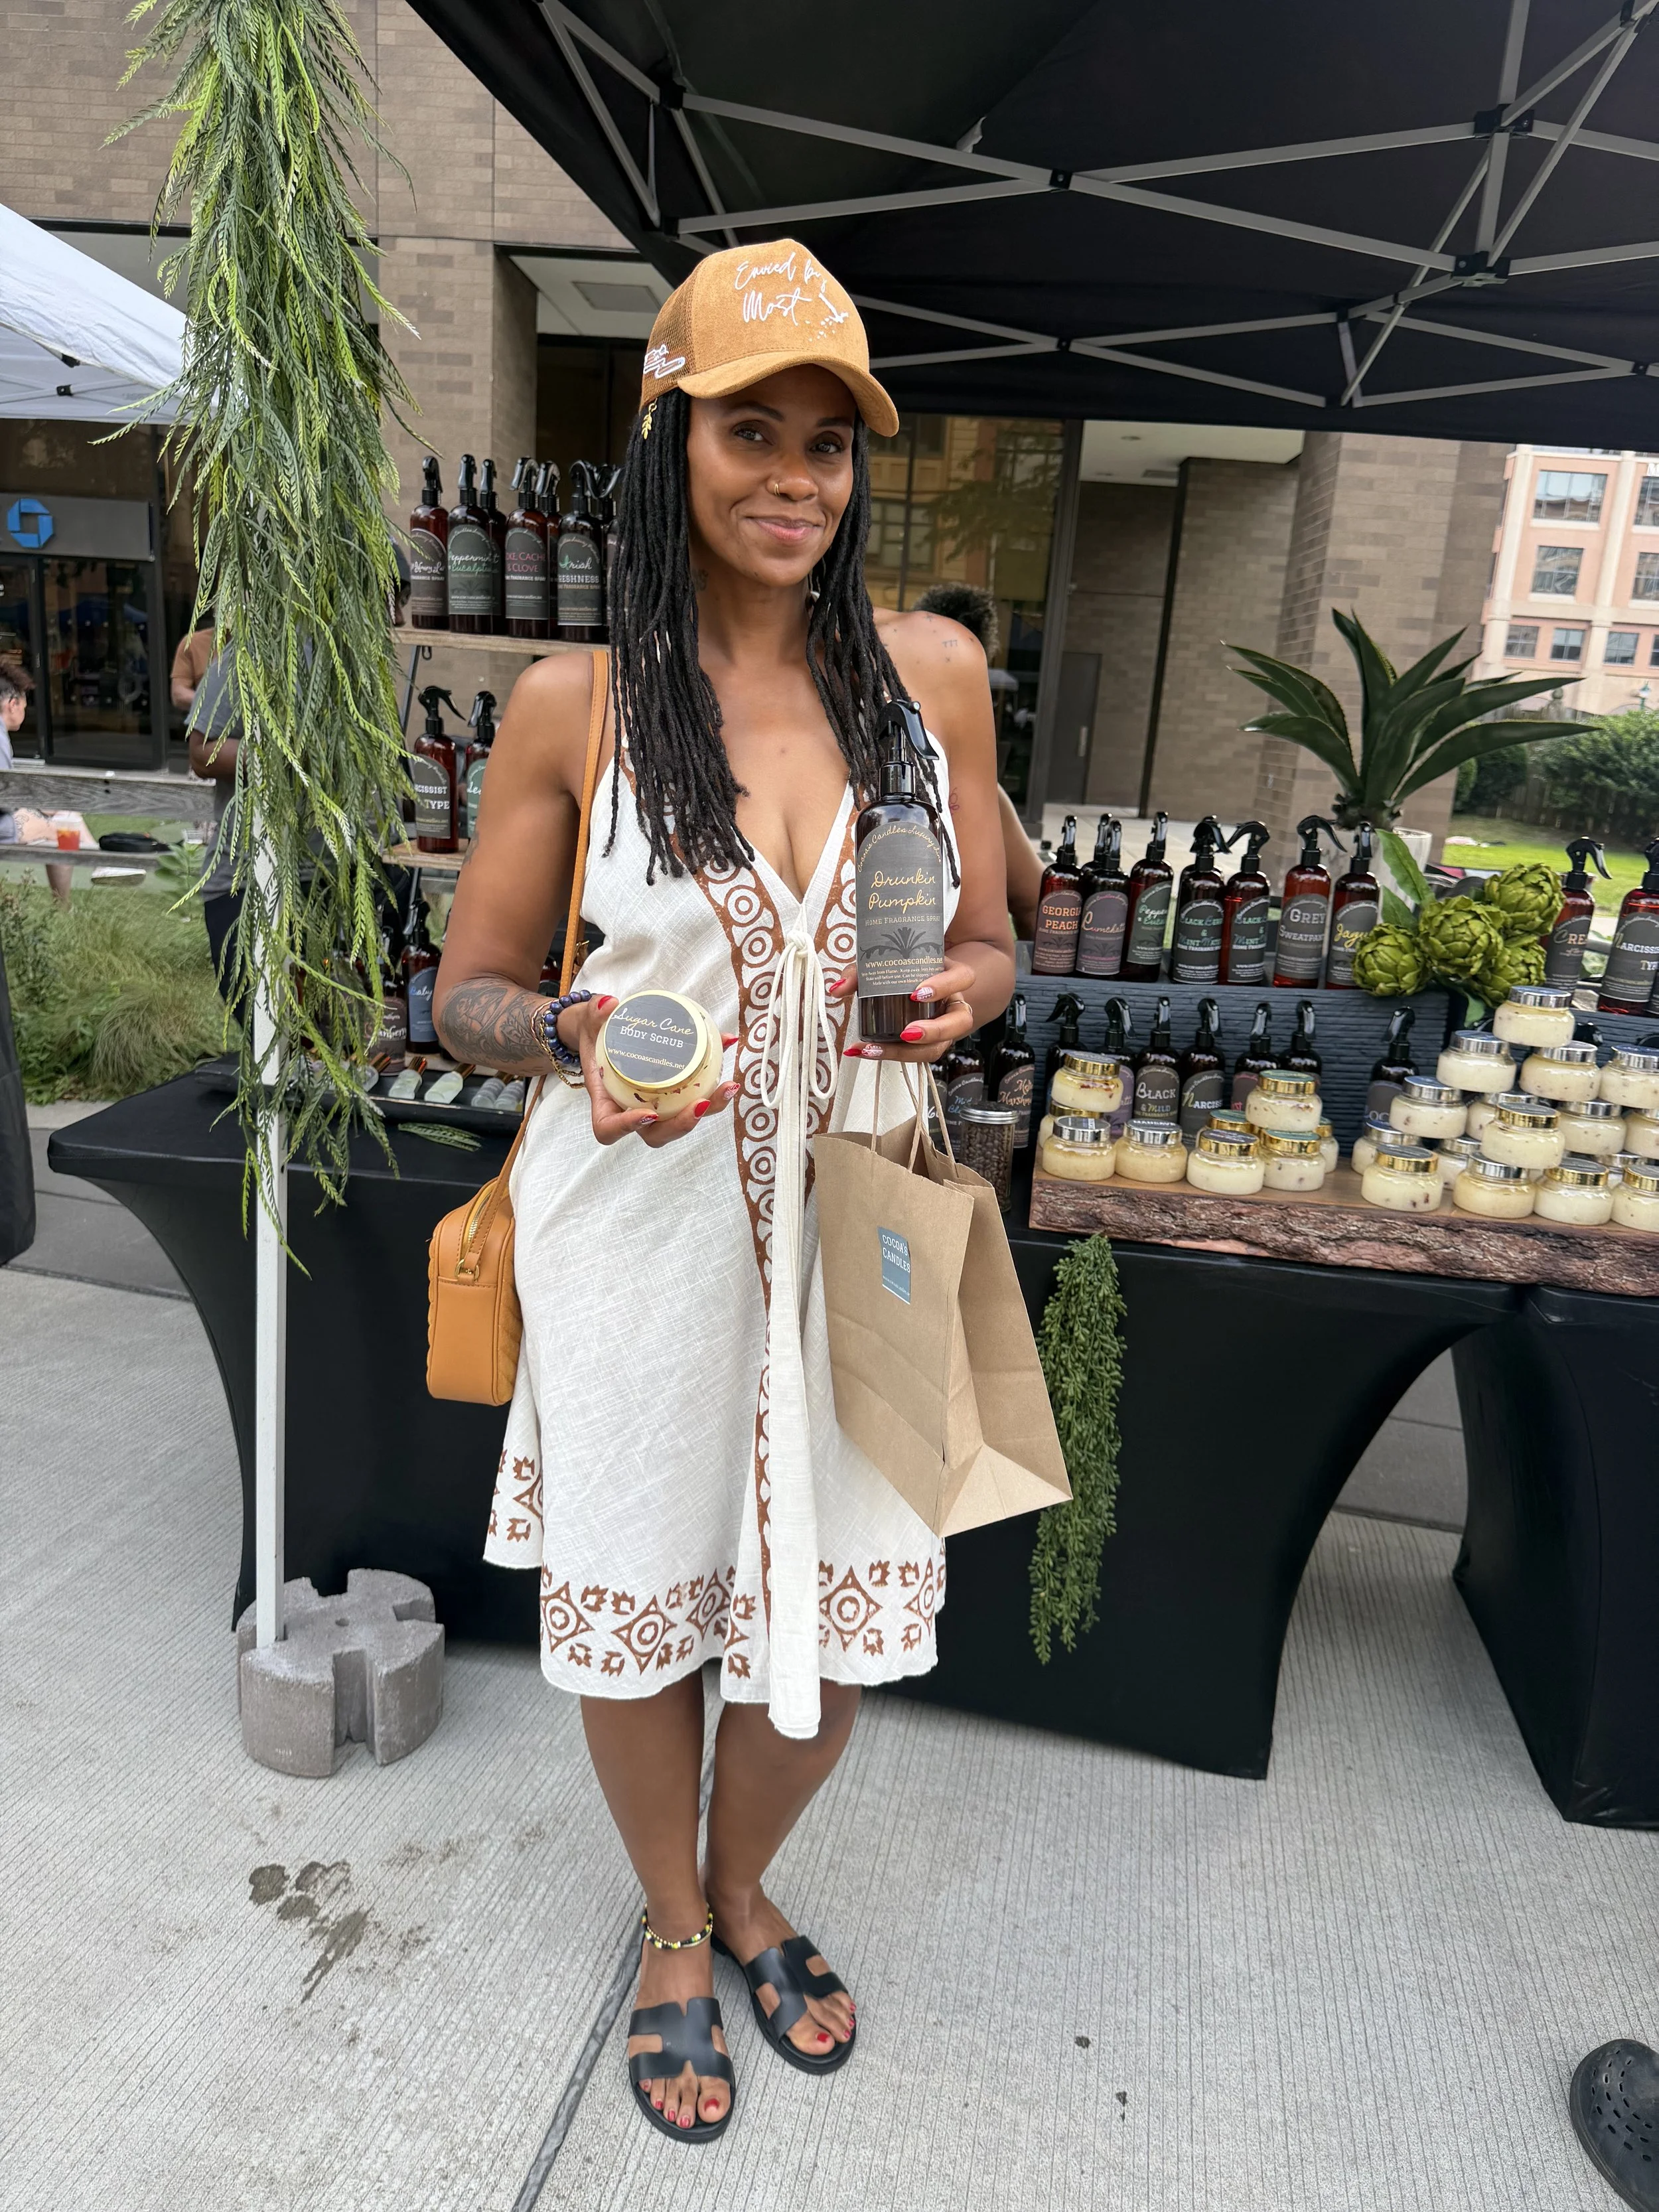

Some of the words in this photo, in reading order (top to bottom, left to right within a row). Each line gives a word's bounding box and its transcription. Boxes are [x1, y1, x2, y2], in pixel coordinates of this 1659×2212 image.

[804, 259, 827, 292] by
[512, 563, 540, 573] CLOVE
[424, 799, 450, 810] TYPE
[872, 826, 907, 844] Candles
[871, 868, 936, 889] Drunkin
[869, 889, 936, 914] Pumpkin
[884, 916, 925, 924] FRAGRANCE
[1045, 919, 1078, 930] PEACH
[610, 1007, 658, 1029] Sugar
[659, 1017, 695, 1035] Cane
[620, 1026, 648, 1040] BODY
[650, 1033, 684, 1048] SCRUB
[607, 1047, 685, 1070] www.cocoascandles.net
[1136, 1082, 1177, 1100] BLACK
[882, 1234, 908, 1256] COCOA'S
[883, 1247, 911, 1274] CANDLES
